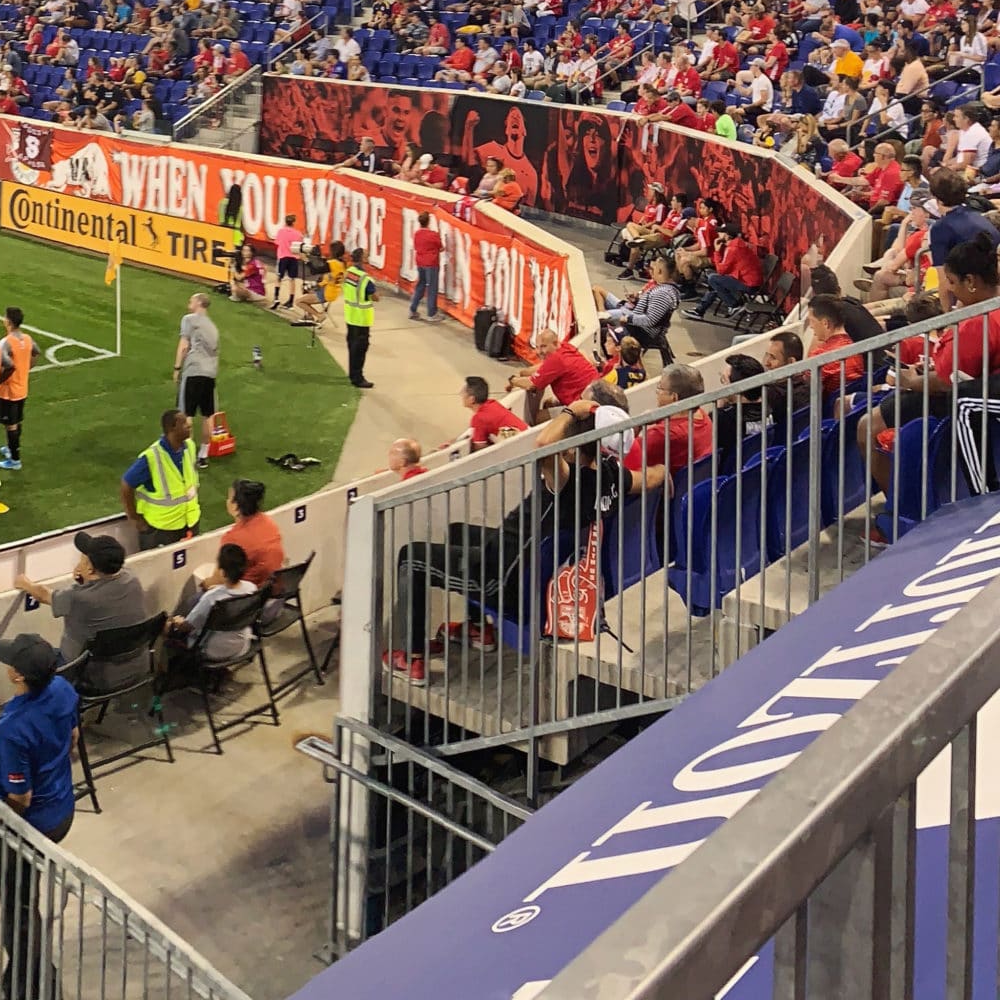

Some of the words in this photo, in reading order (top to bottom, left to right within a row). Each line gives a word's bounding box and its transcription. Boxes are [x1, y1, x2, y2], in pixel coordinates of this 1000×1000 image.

[9, 188, 138, 248] Continental
[167, 230, 226, 268] TIRE
[112, 151, 208, 223] WHEN
[301, 177, 387, 270] WERE
[479, 240, 525, 336] YOU
